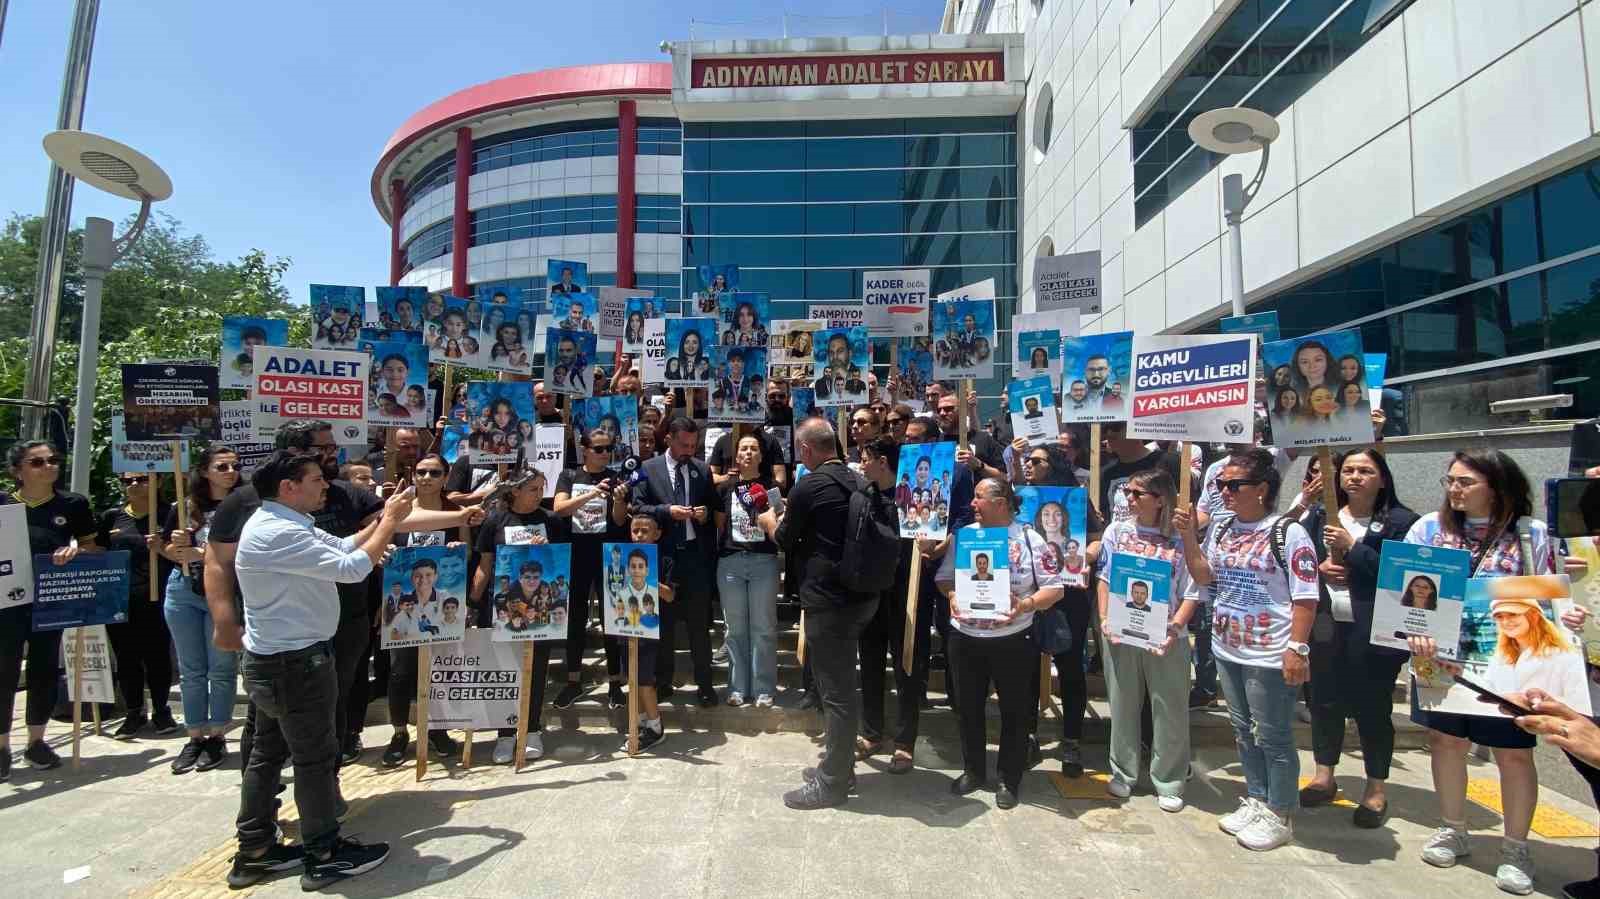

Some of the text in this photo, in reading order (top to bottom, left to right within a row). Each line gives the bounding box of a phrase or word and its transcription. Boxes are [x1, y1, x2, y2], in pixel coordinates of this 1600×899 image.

[702, 59, 994, 87] ADIYAMAN ADALET SARAYI
[866, 279, 903, 290] KADER
[866, 292, 926, 305] CİNAYET
[646, 338, 665, 347] OLA
[1138, 350, 1191, 369] KAMU
[264, 356, 361, 377] ADALET
[1137, 359, 1247, 388] GÖREVLİLERİ
[260, 379, 361, 396] OLASI KAST
[1137, 387, 1245, 411] YARGILANSIN
[260, 402, 361, 416] İLE GELECEK
[537, 451, 562, 460] AST
[433, 655, 480, 667] Adalet
[431, 671, 517, 683] OLASI KAST
[449, 687, 519, 700] GELECEK!
